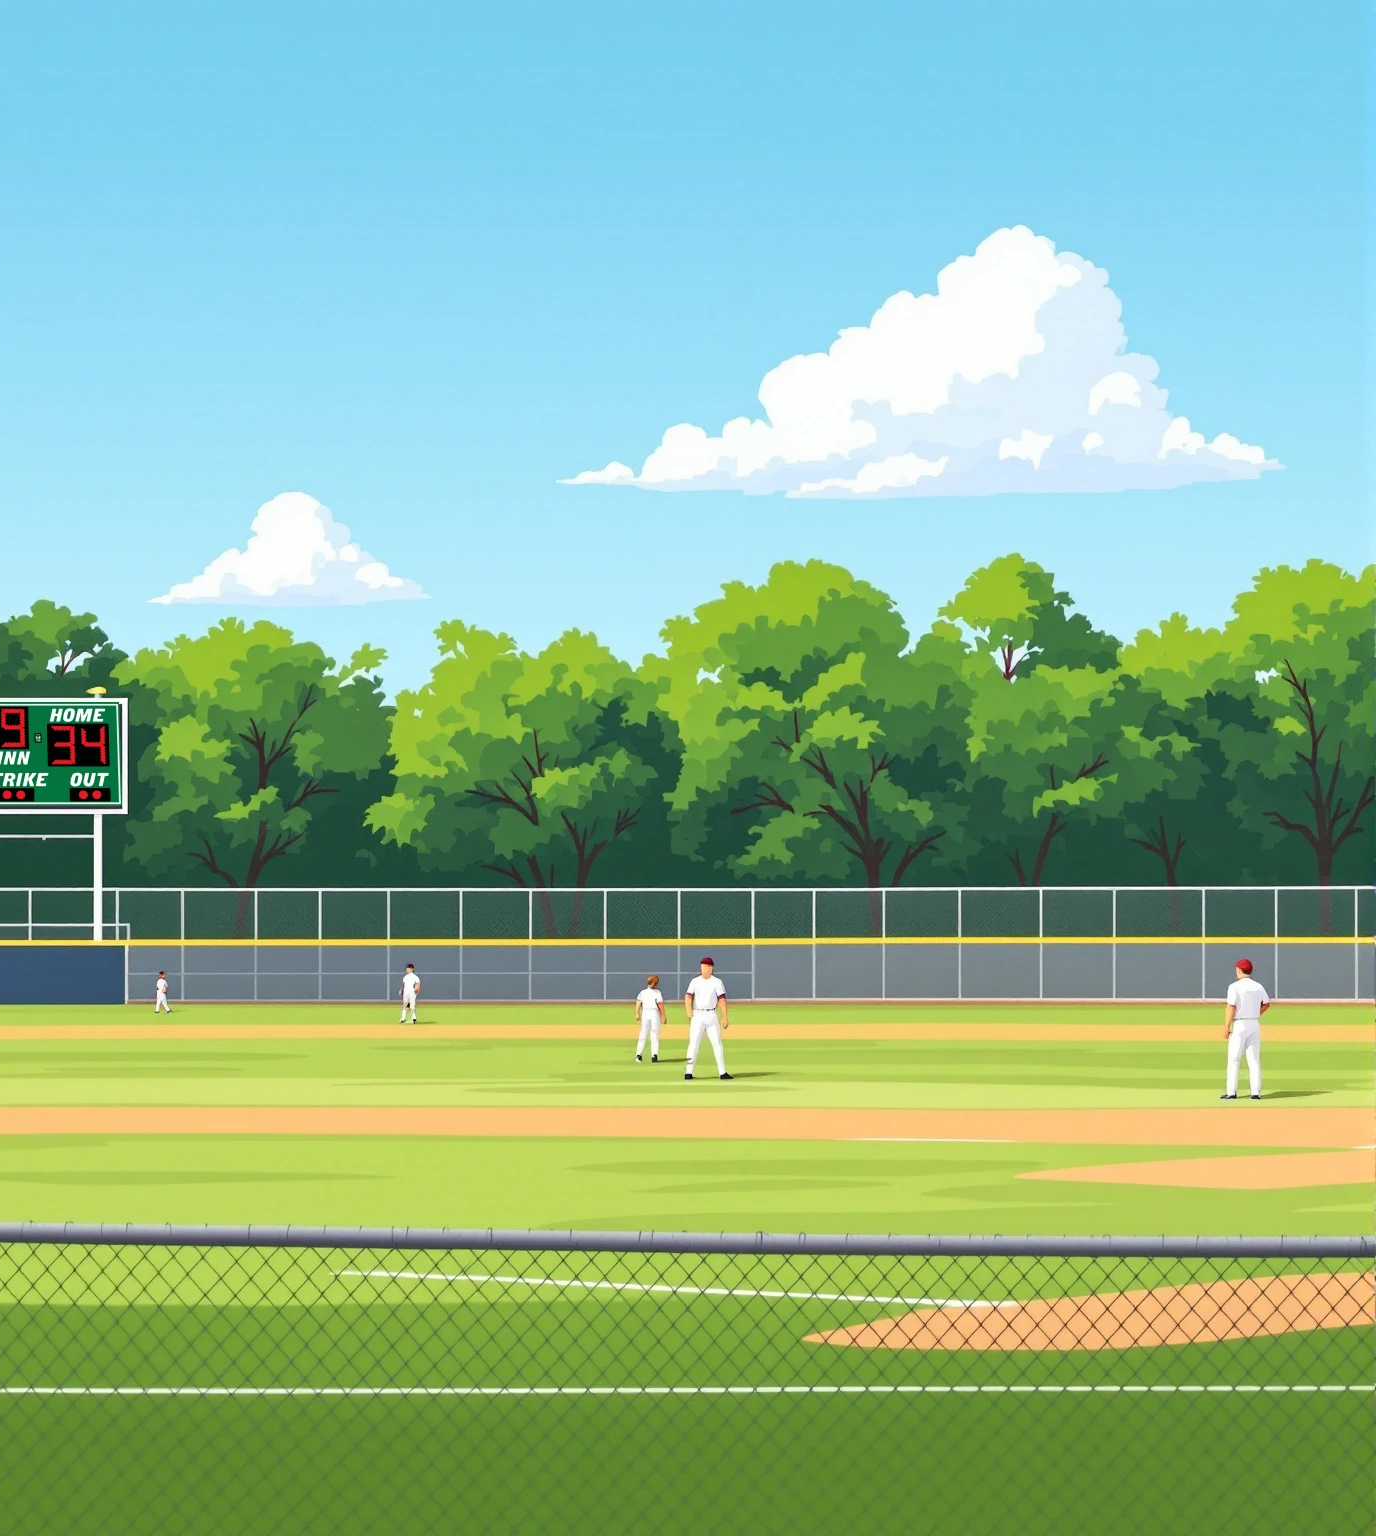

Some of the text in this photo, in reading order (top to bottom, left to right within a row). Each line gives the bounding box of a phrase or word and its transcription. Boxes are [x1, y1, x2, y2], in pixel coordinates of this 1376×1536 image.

[1, 708, 26, 748] 9
[49, 708, 106, 723] HOME
[51, 725, 107, 765] 34
[69, 772, 110, 787] OUT
